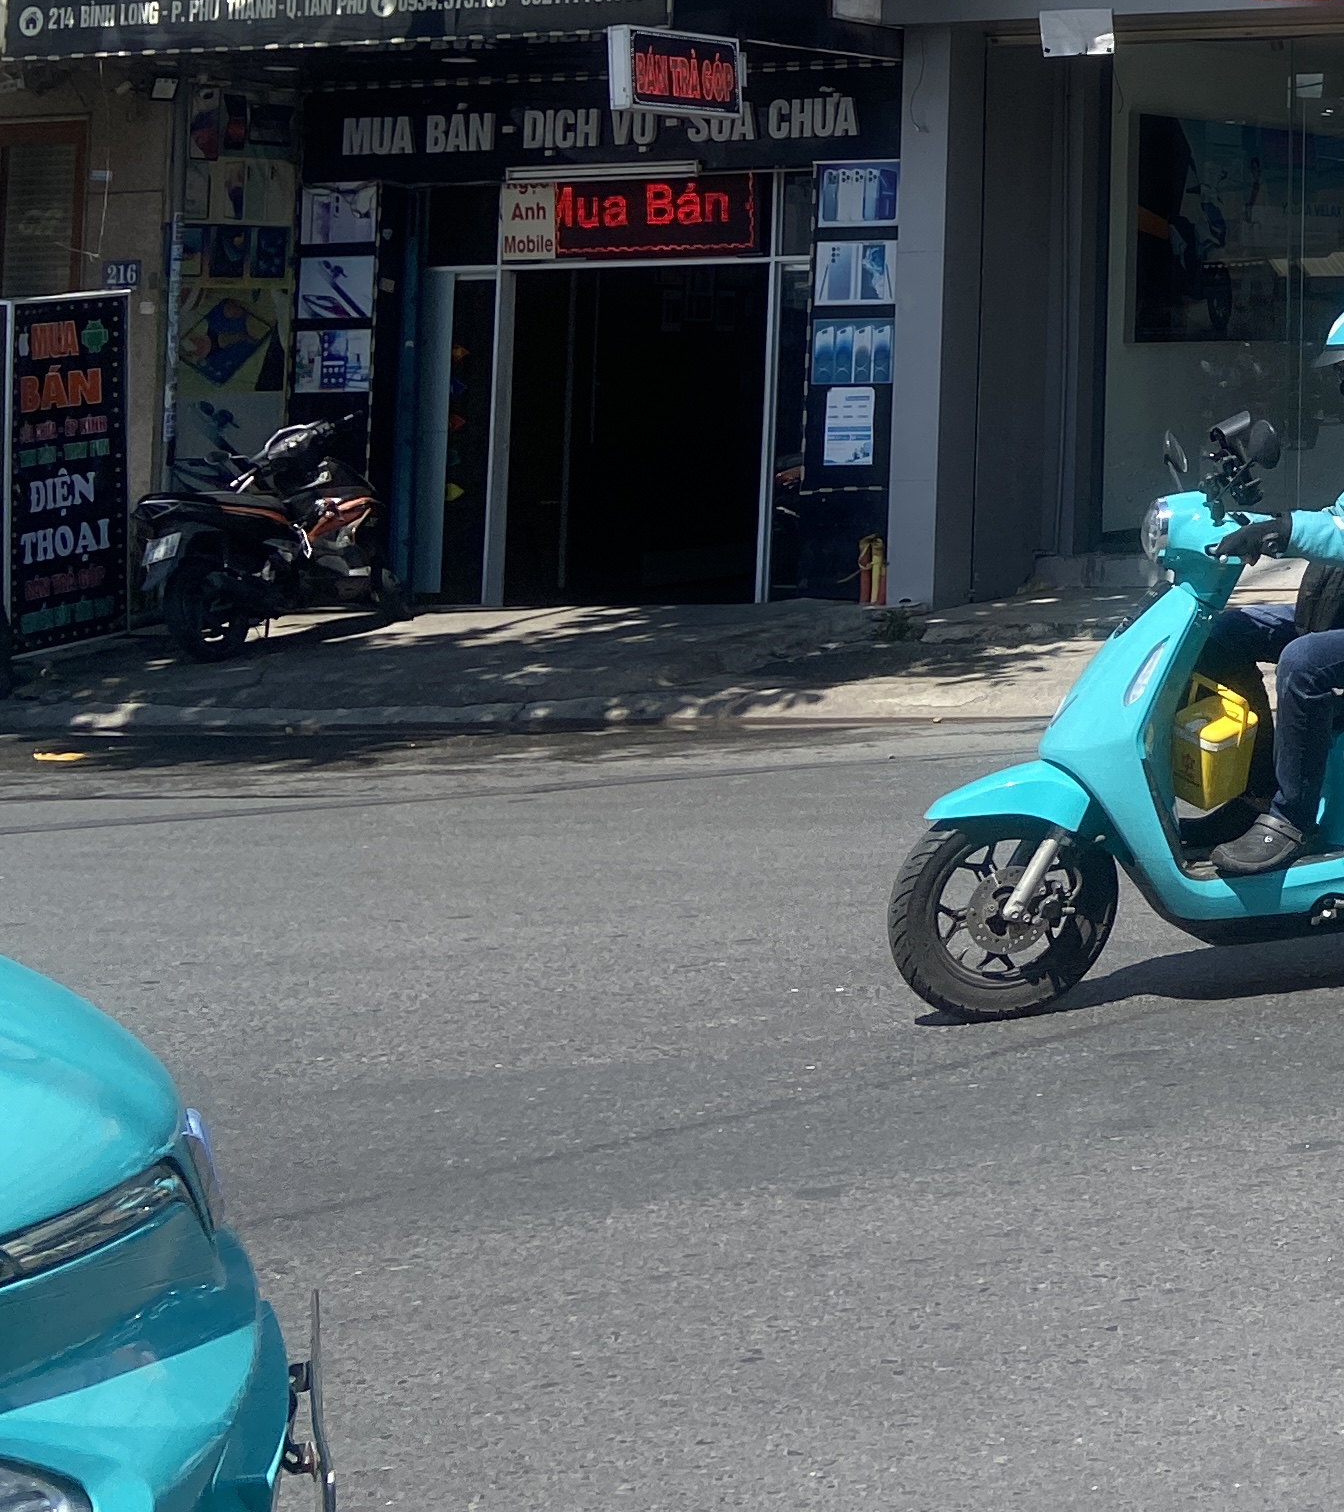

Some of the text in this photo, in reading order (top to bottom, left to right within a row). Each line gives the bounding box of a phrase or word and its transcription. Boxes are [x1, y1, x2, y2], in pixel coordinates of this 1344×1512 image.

[48, 7, 74, 30] 214
[80, 0, 115, 29] BÌNH
[120, 0, 159, 26] LONG
[635, 45, 735, 103] BÁN TRẢ GÓP
[342, 115, 416, 156] MUA
[426, 102, 496, 154] BÁN
[522, 108, 600, 157] DỊCH
[768, 86, 859, 139] CHỮA
[511, 202, 547, 221] Anh
[646, 182, 730, 226] Bán
[504, 234, 553, 254] Mobile
[107, 264, 137, 285] 216
[31, 320, 80, 360] MUA
[20, 365, 103, 413] BÁN
[29, 467, 96, 517] ĐIỆN
[20, 518, 110, 564] THOẠI
